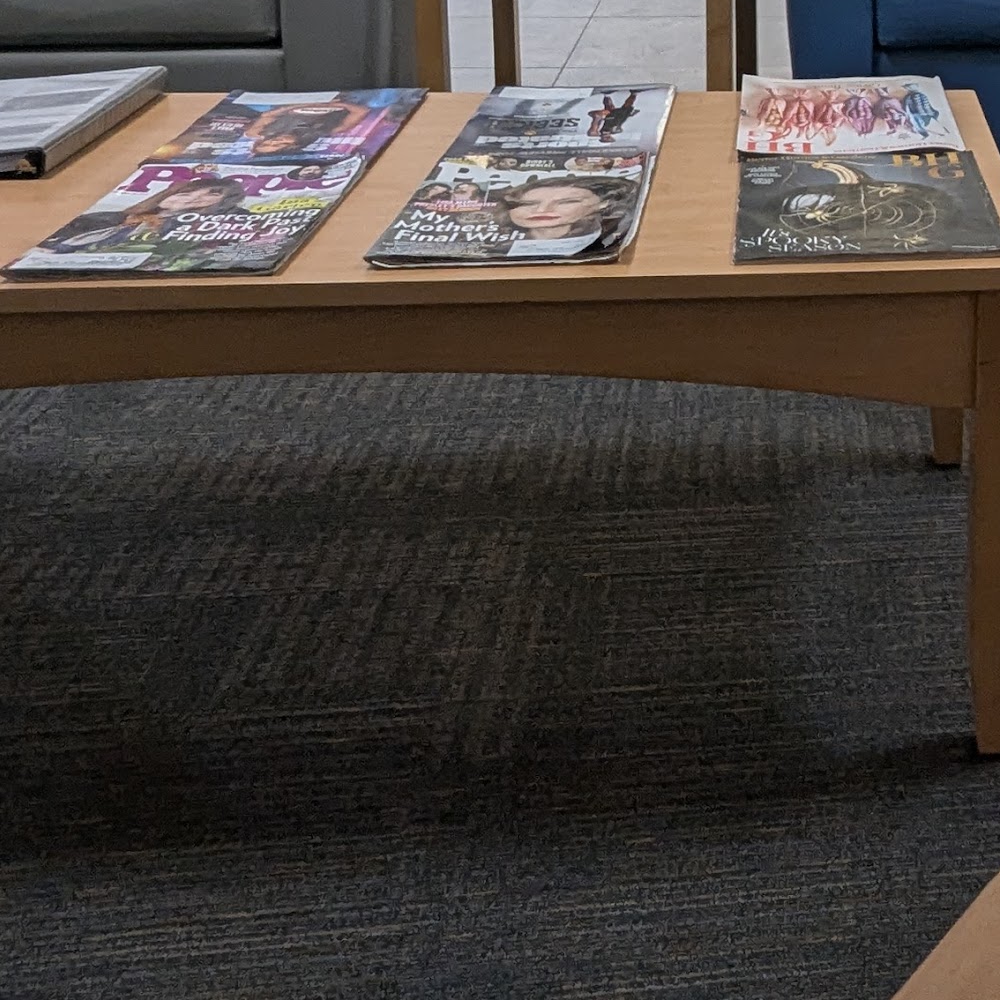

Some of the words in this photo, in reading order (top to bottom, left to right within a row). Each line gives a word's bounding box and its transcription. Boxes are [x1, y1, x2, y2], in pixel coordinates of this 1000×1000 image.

[117, 166, 352, 196] Pope
[435, 162, 642, 188] Pee
[177, 208, 321, 224] Overcoming
[176, 223, 190, 232] a
[197, 220, 254, 231] Dark
[393, 219, 500, 232] Mother's
[162, 231, 256, 242] Finding
[394, 230, 457, 242] Final
[465, 230, 527, 242] Wish
[739, 234, 848, 248] SPOOKY
[767, 242, 862, 252] SEASON
